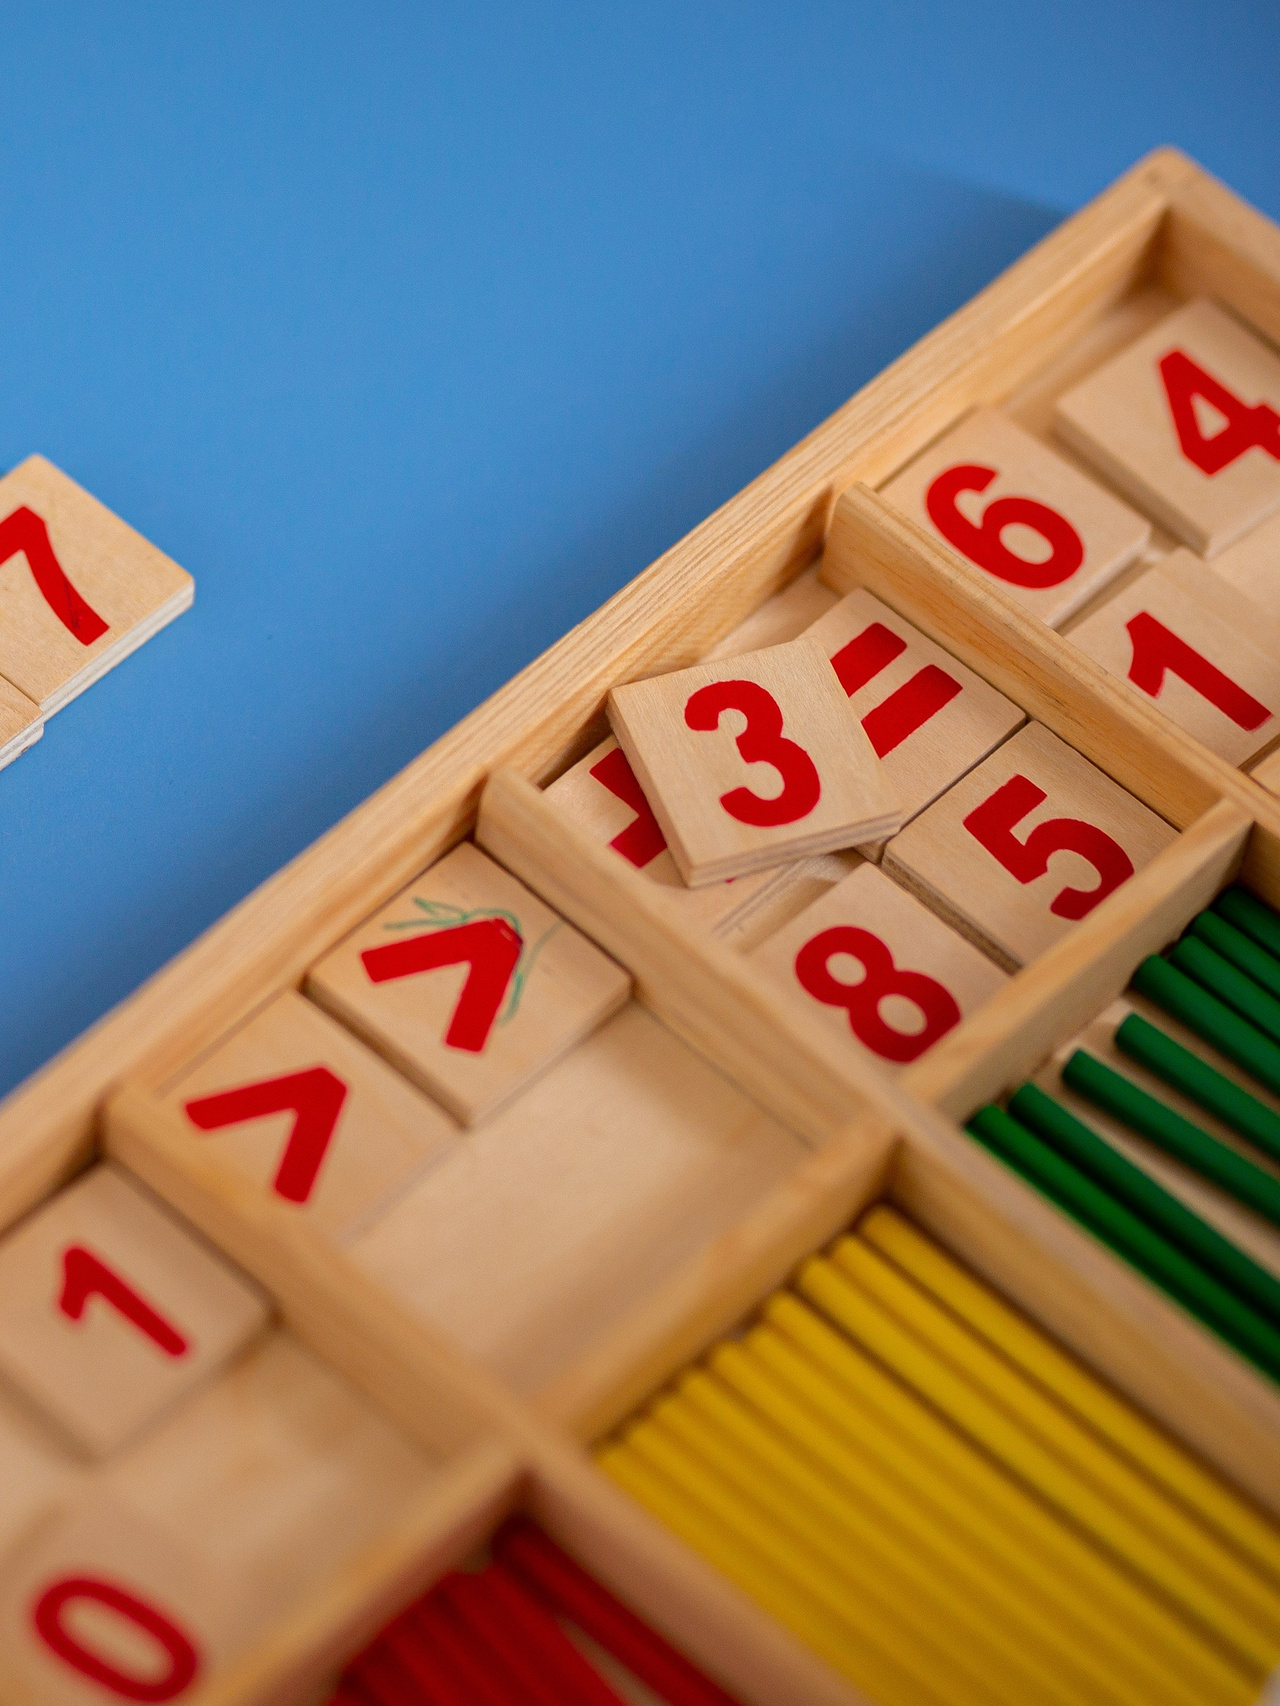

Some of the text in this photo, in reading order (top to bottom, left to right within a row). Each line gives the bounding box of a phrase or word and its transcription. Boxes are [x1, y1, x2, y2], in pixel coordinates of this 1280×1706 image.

[1156, 348, 1280, 478] 4
[925, 463, 1085, 590] 6
[1125, 611, 1274, 733] 1
[684, 680, 821, 828] 3
[962, 774, 1135, 922] 5
[793, 925, 963, 1066] 8
[55, 1241, 194, 1362] 1
[33, 1571, 200, 1704] 0
